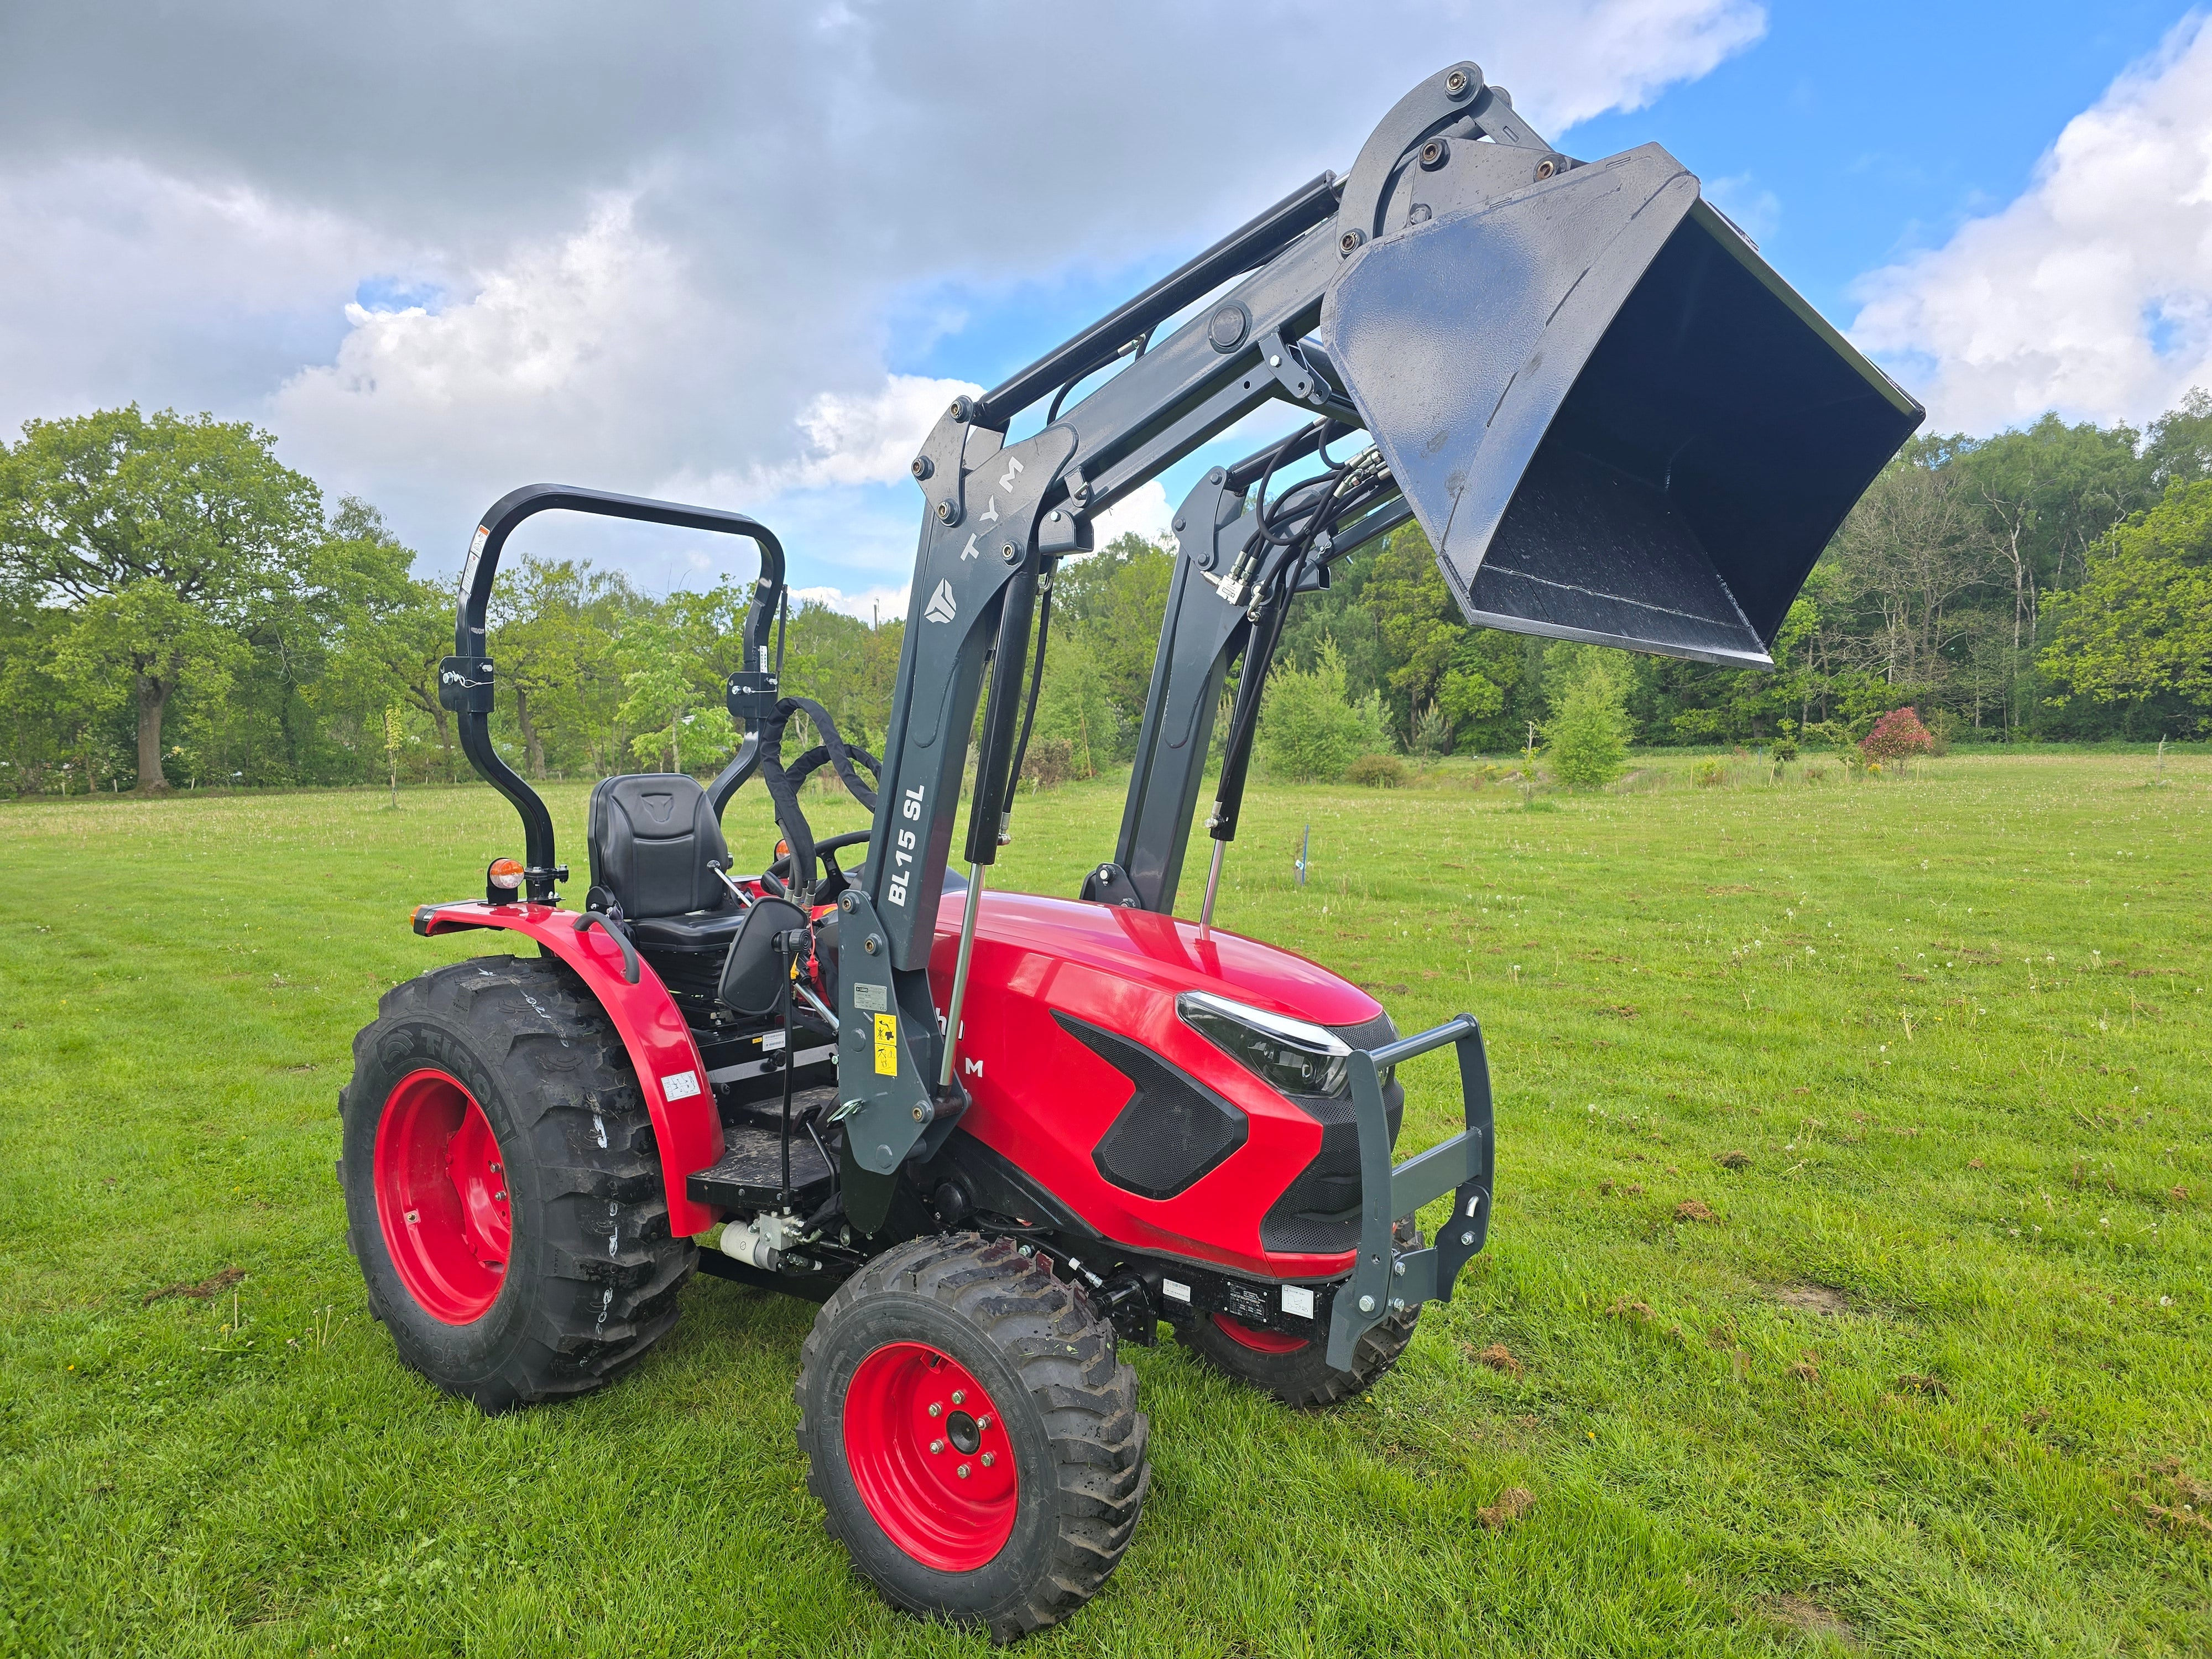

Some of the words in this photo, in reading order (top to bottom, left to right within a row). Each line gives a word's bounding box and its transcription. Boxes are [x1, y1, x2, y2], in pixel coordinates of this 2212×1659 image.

[960, 456, 1024, 561] TYM
[888, 828, 916, 907] BL15
[903, 785, 925, 821] SL
[420, 1028, 511, 1142] TIRON
